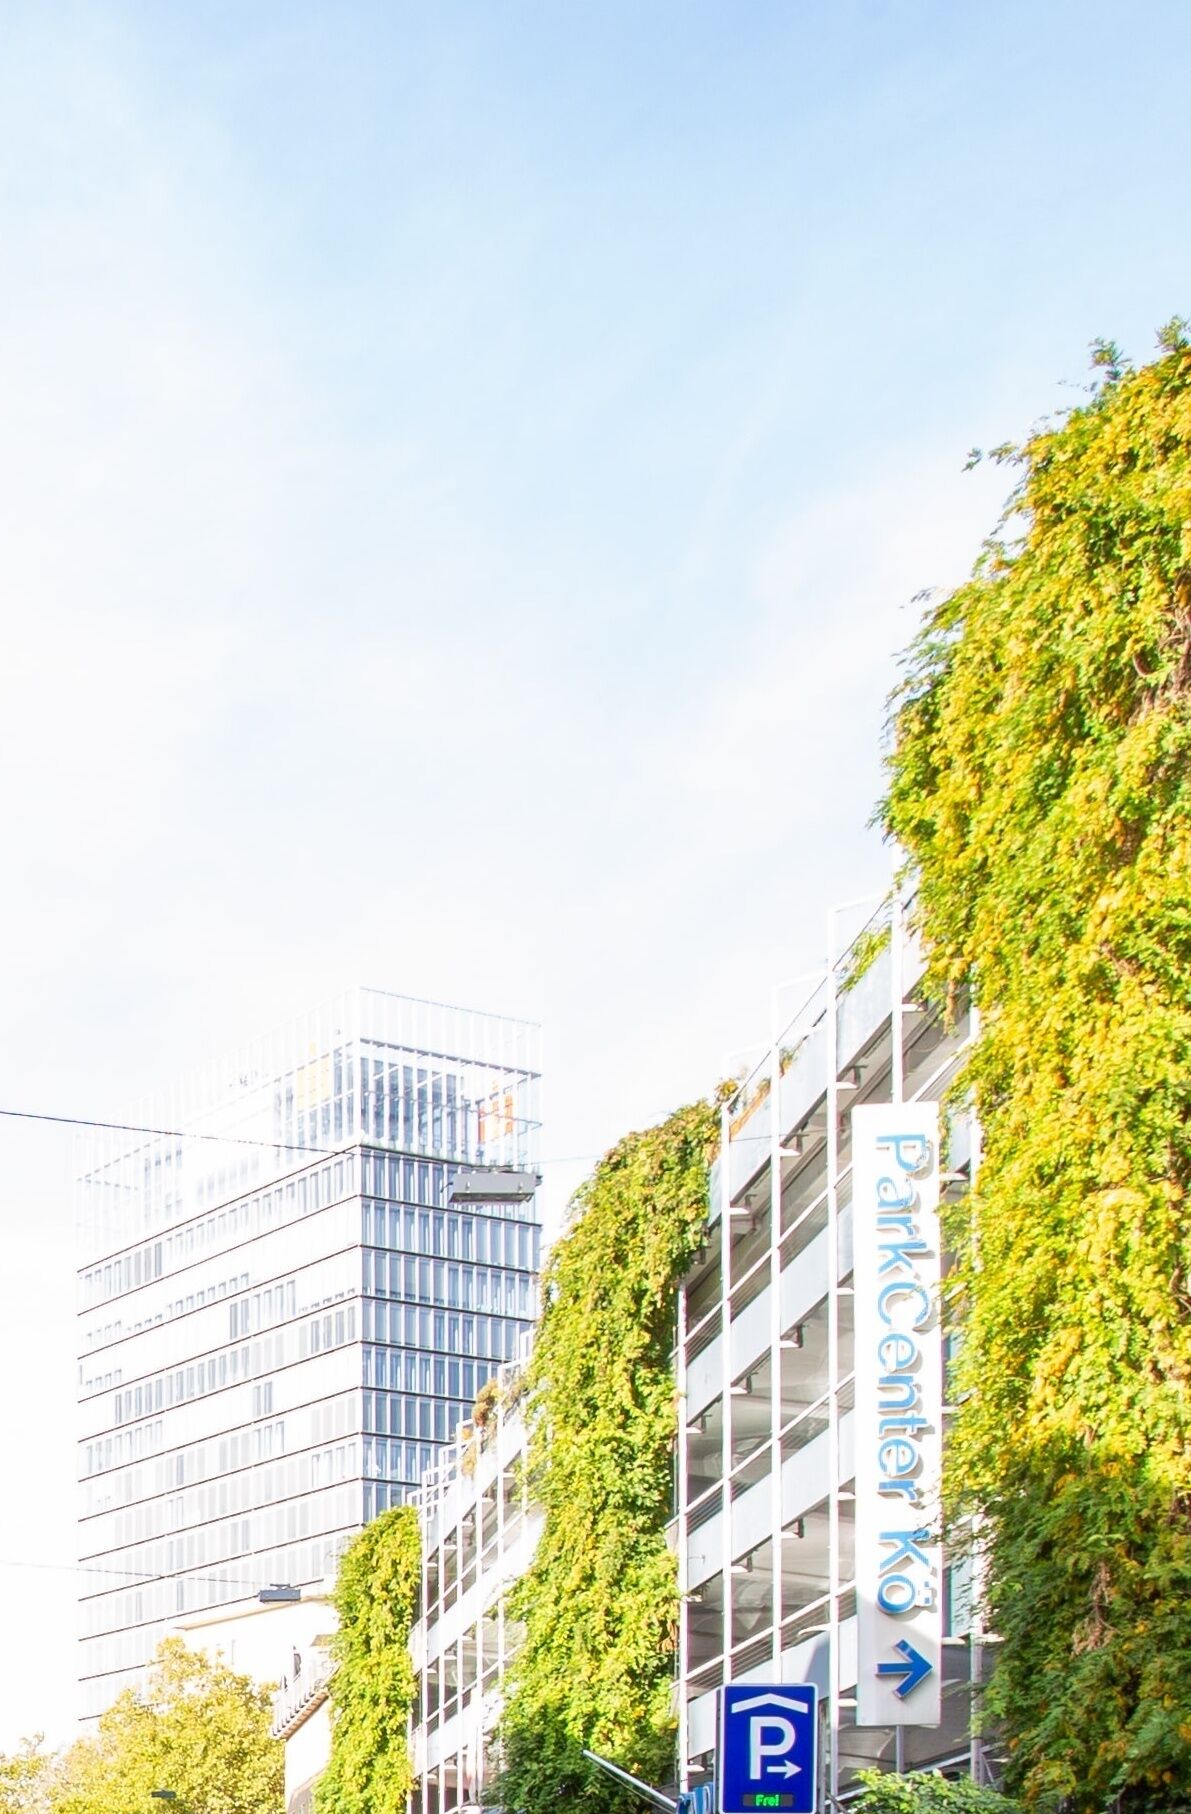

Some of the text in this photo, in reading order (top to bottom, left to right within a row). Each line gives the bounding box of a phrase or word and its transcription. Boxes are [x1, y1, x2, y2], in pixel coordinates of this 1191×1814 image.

[876, 1134, 930, 1613] ParkCenter Kö
[749, 1716, 796, 1780] P
[755, 1794, 780, 1806] Frei
